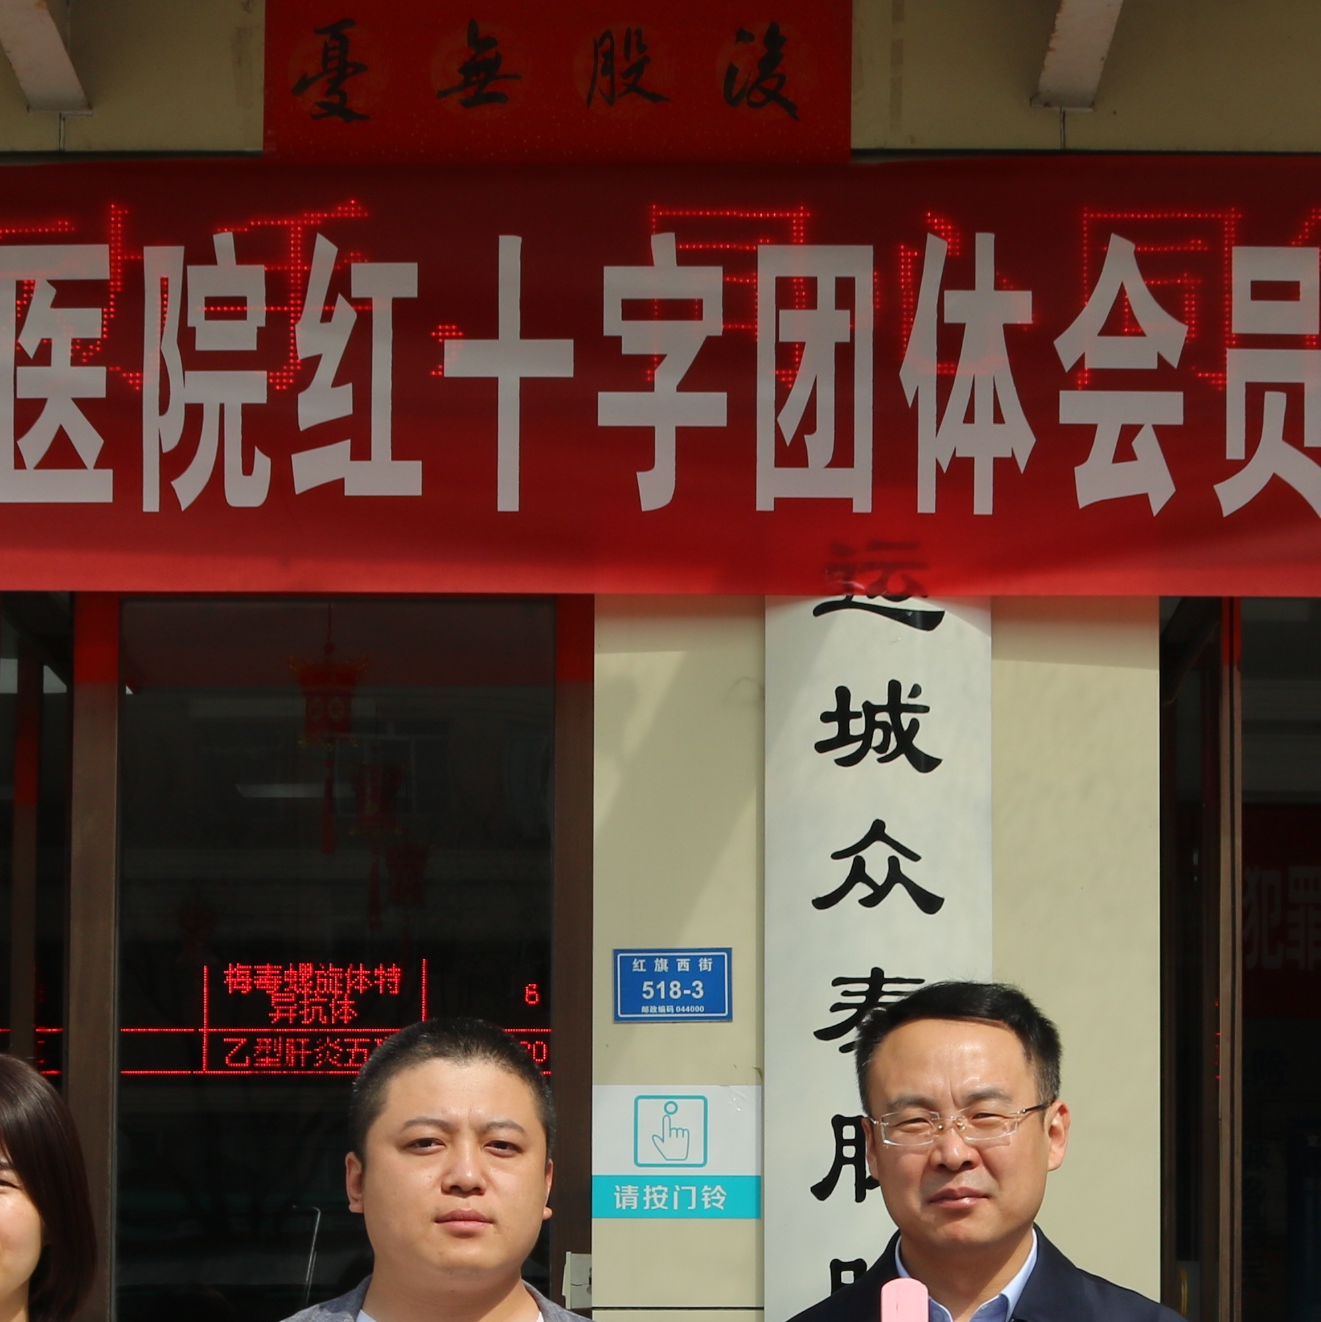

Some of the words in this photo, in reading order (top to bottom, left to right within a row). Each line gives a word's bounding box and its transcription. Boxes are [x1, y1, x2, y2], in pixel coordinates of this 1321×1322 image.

[632, 957, 714, 973] 红旗西街
[223, 962, 403, 995] 梅毒螺旋体特
[641, 980, 705, 1000] 518-3
[524, 983, 541, 1005] 6
[268, 992, 359, 1025] 异抗体
[641, 1005, 675, 1014] 邮政编码
[676, 1005, 705, 1013] 044000
[223, 1036, 389, 1068] 乙型肝炎五
[613, 1184, 728, 1211] 请按门铃
